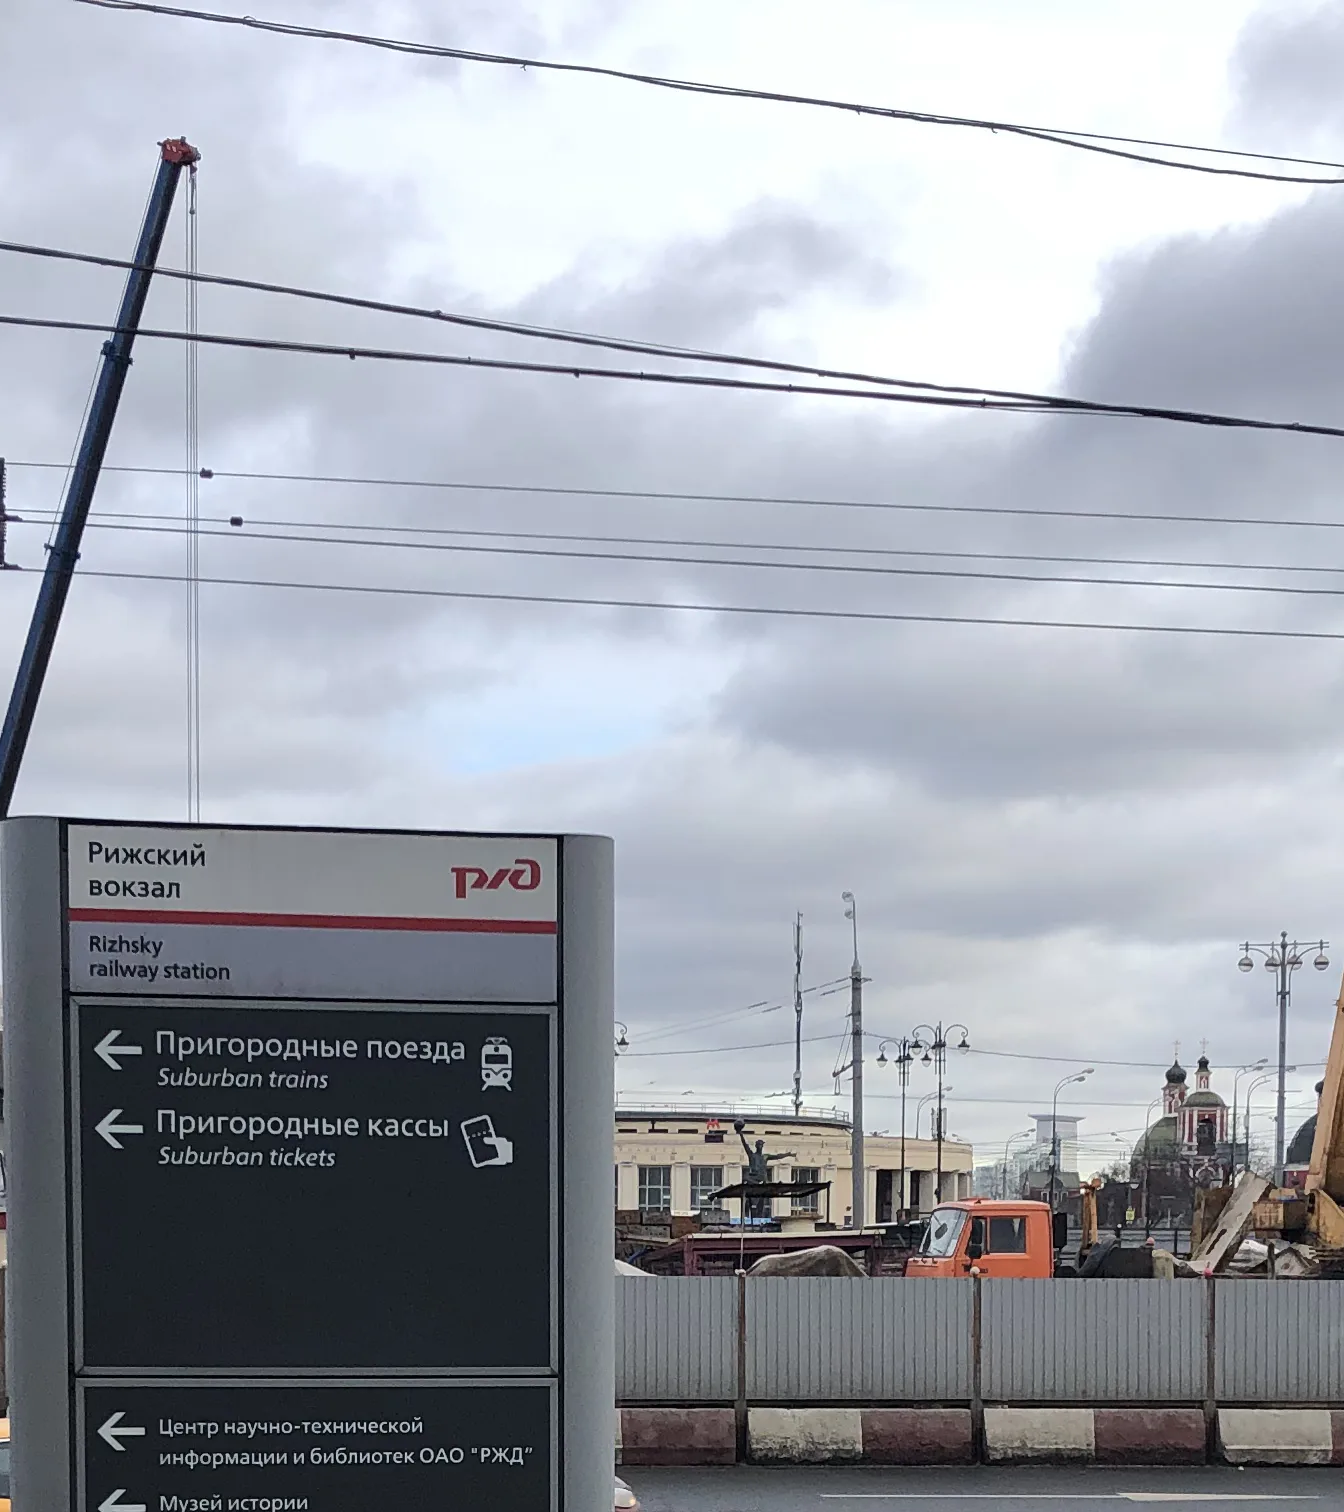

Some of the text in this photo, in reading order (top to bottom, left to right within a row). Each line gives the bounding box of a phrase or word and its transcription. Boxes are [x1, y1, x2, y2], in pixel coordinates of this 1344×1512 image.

[88, 841, 206, 867] Рижский
[88, 878, 181, 899] вокзал
[89, 934, 163, 958] Rizhsky
[89, 959, 230, 982] railway station
[156, 1030, 465, 1063] Пригородные поезда
[158, 1067, 328, 1089] Suburban trains
[157, 1110, 449, 1140] Пригородные кассы
[159, 1146, 336, 1167] Suburban tickets
[159, 1416, 423, 1438] Центр научно-технической
[159, 1449, 288, 1469] информации
[294, 1452, 304, 1465] и
[310, 1447, 414, 1465] библиотек
[419, 1447, 464, 1464] ОАО
